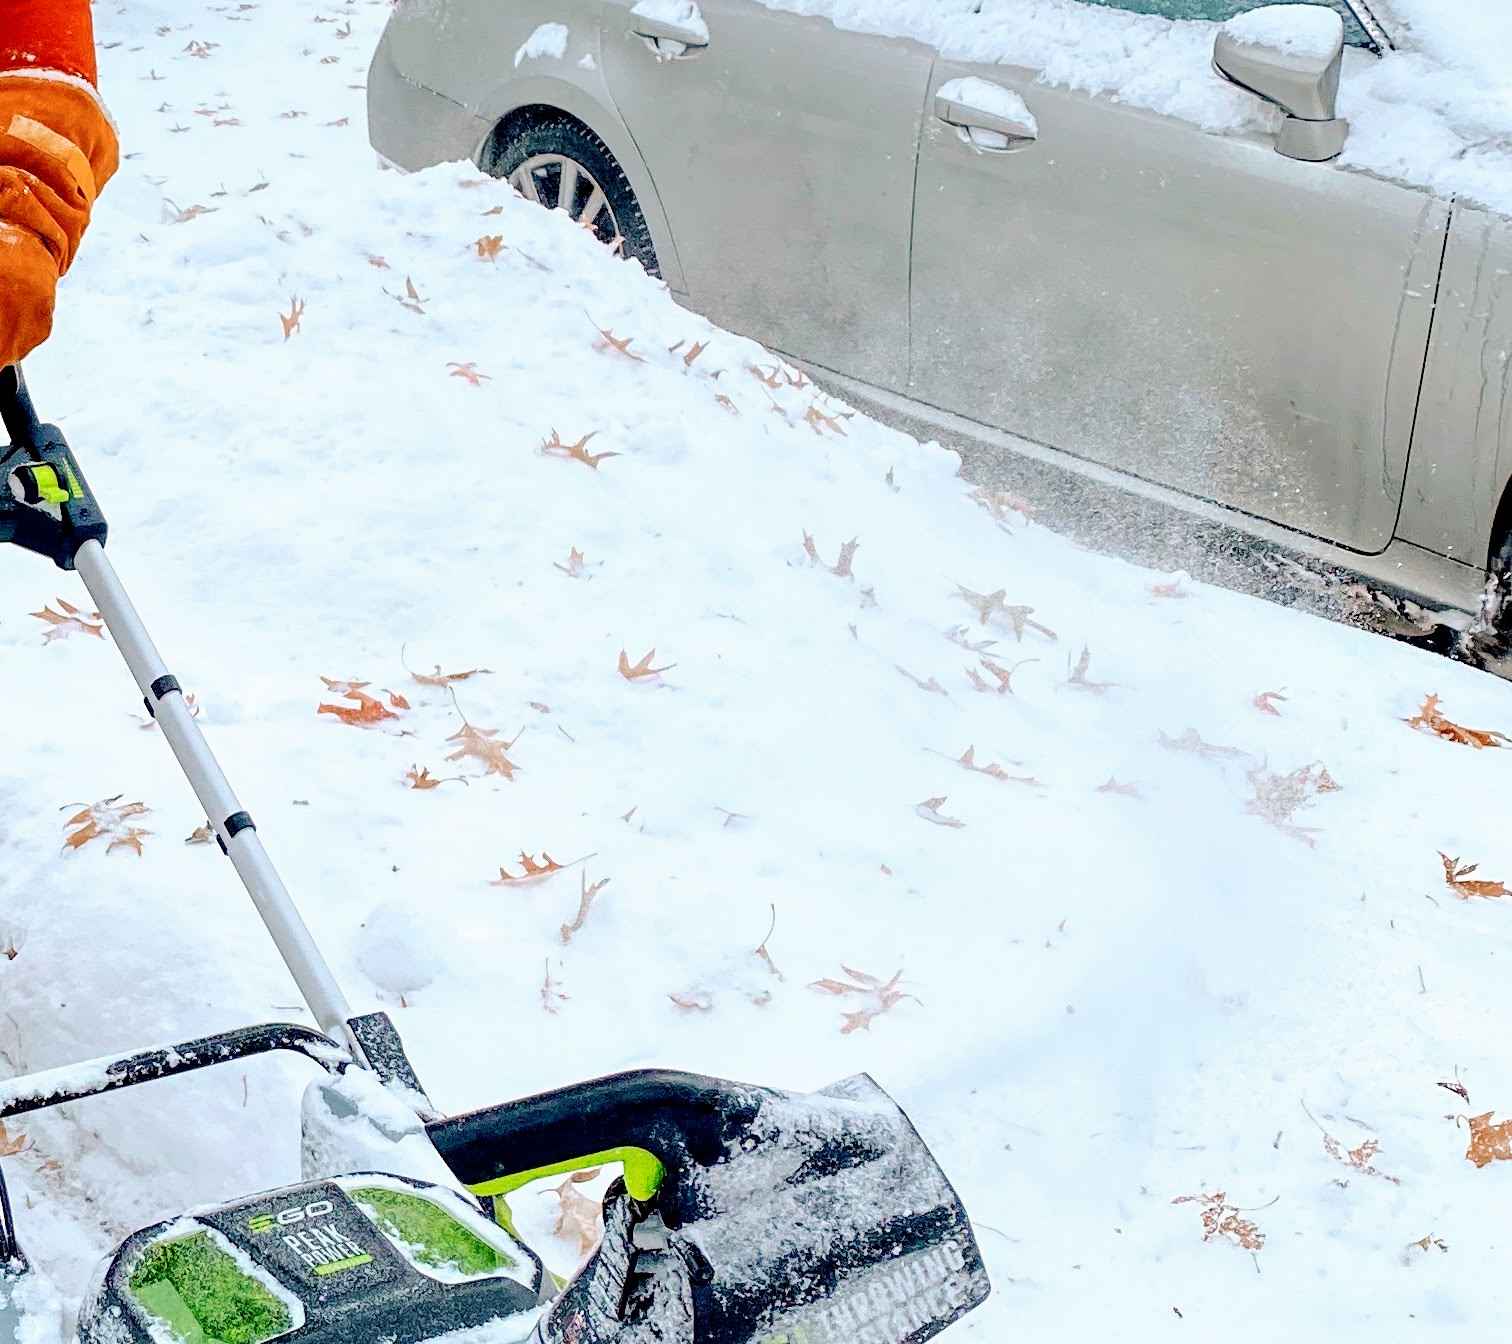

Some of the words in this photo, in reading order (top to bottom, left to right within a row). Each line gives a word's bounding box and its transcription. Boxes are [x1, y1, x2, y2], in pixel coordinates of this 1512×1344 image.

[248, 1200, 334, 1234] EGO
[282, 1223, 351, 1256] PEAK
[300, 1240, 367, 1268] POWER
[815, 1239, 966, 1339] THROWING
